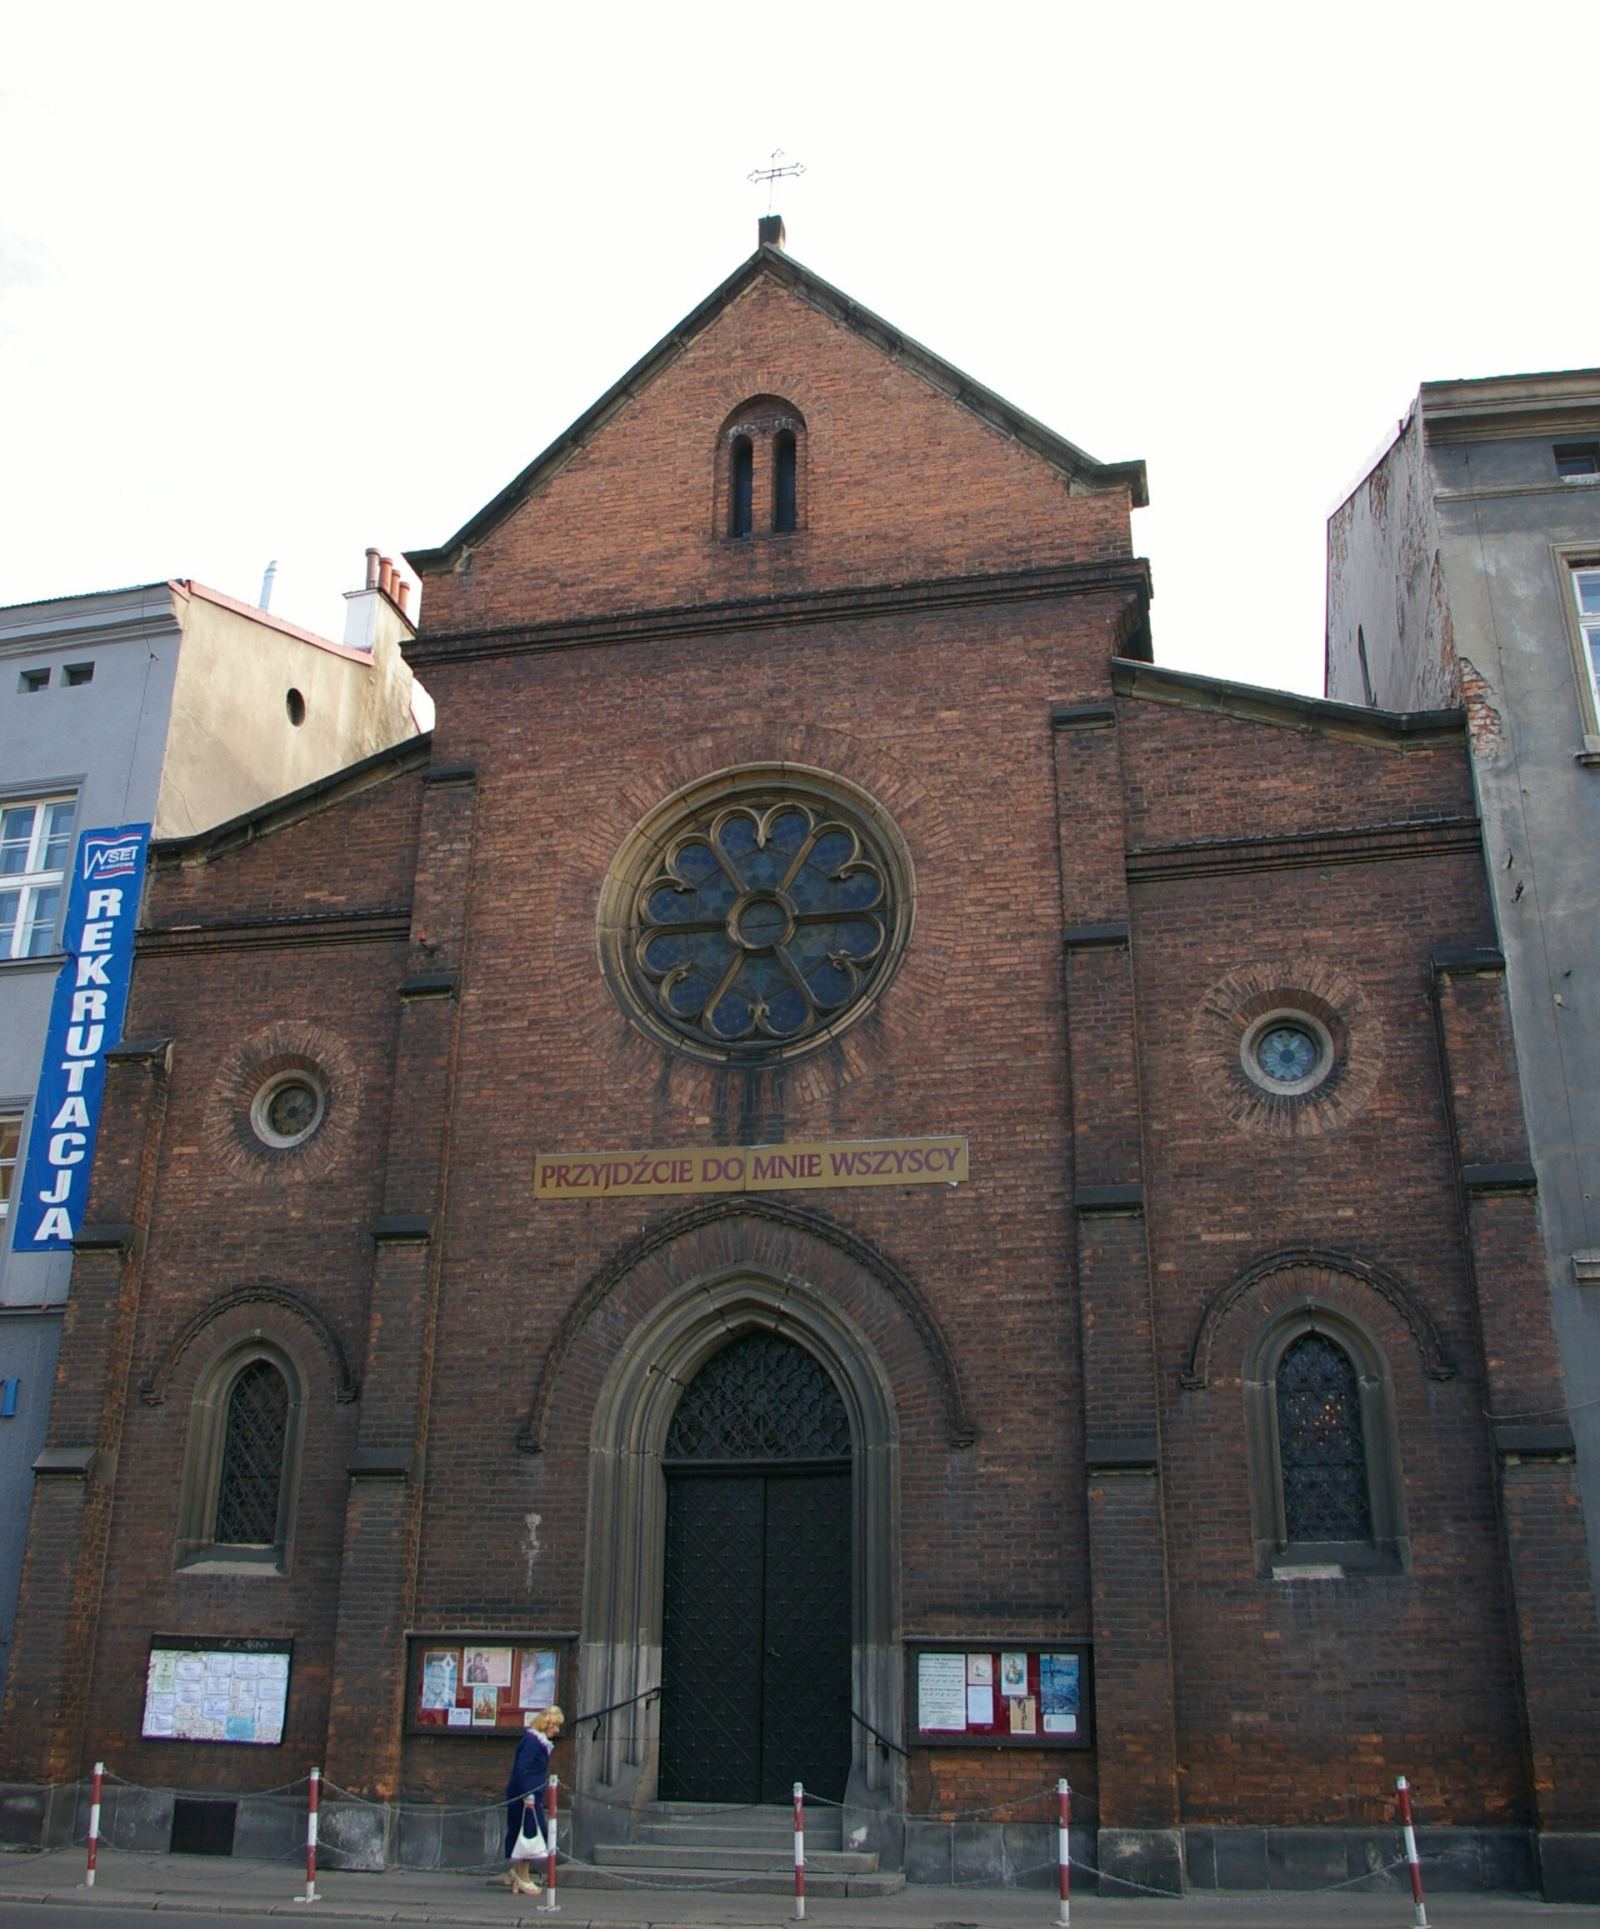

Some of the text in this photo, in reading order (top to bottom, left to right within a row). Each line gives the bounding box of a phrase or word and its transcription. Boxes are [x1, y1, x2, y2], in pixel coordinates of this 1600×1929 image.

[33, 887, 124, 1242] REKRUTACJA
[540, 1147, 961, 1191] PRZYJDŹCIE DO MNIE WSZYSCY
